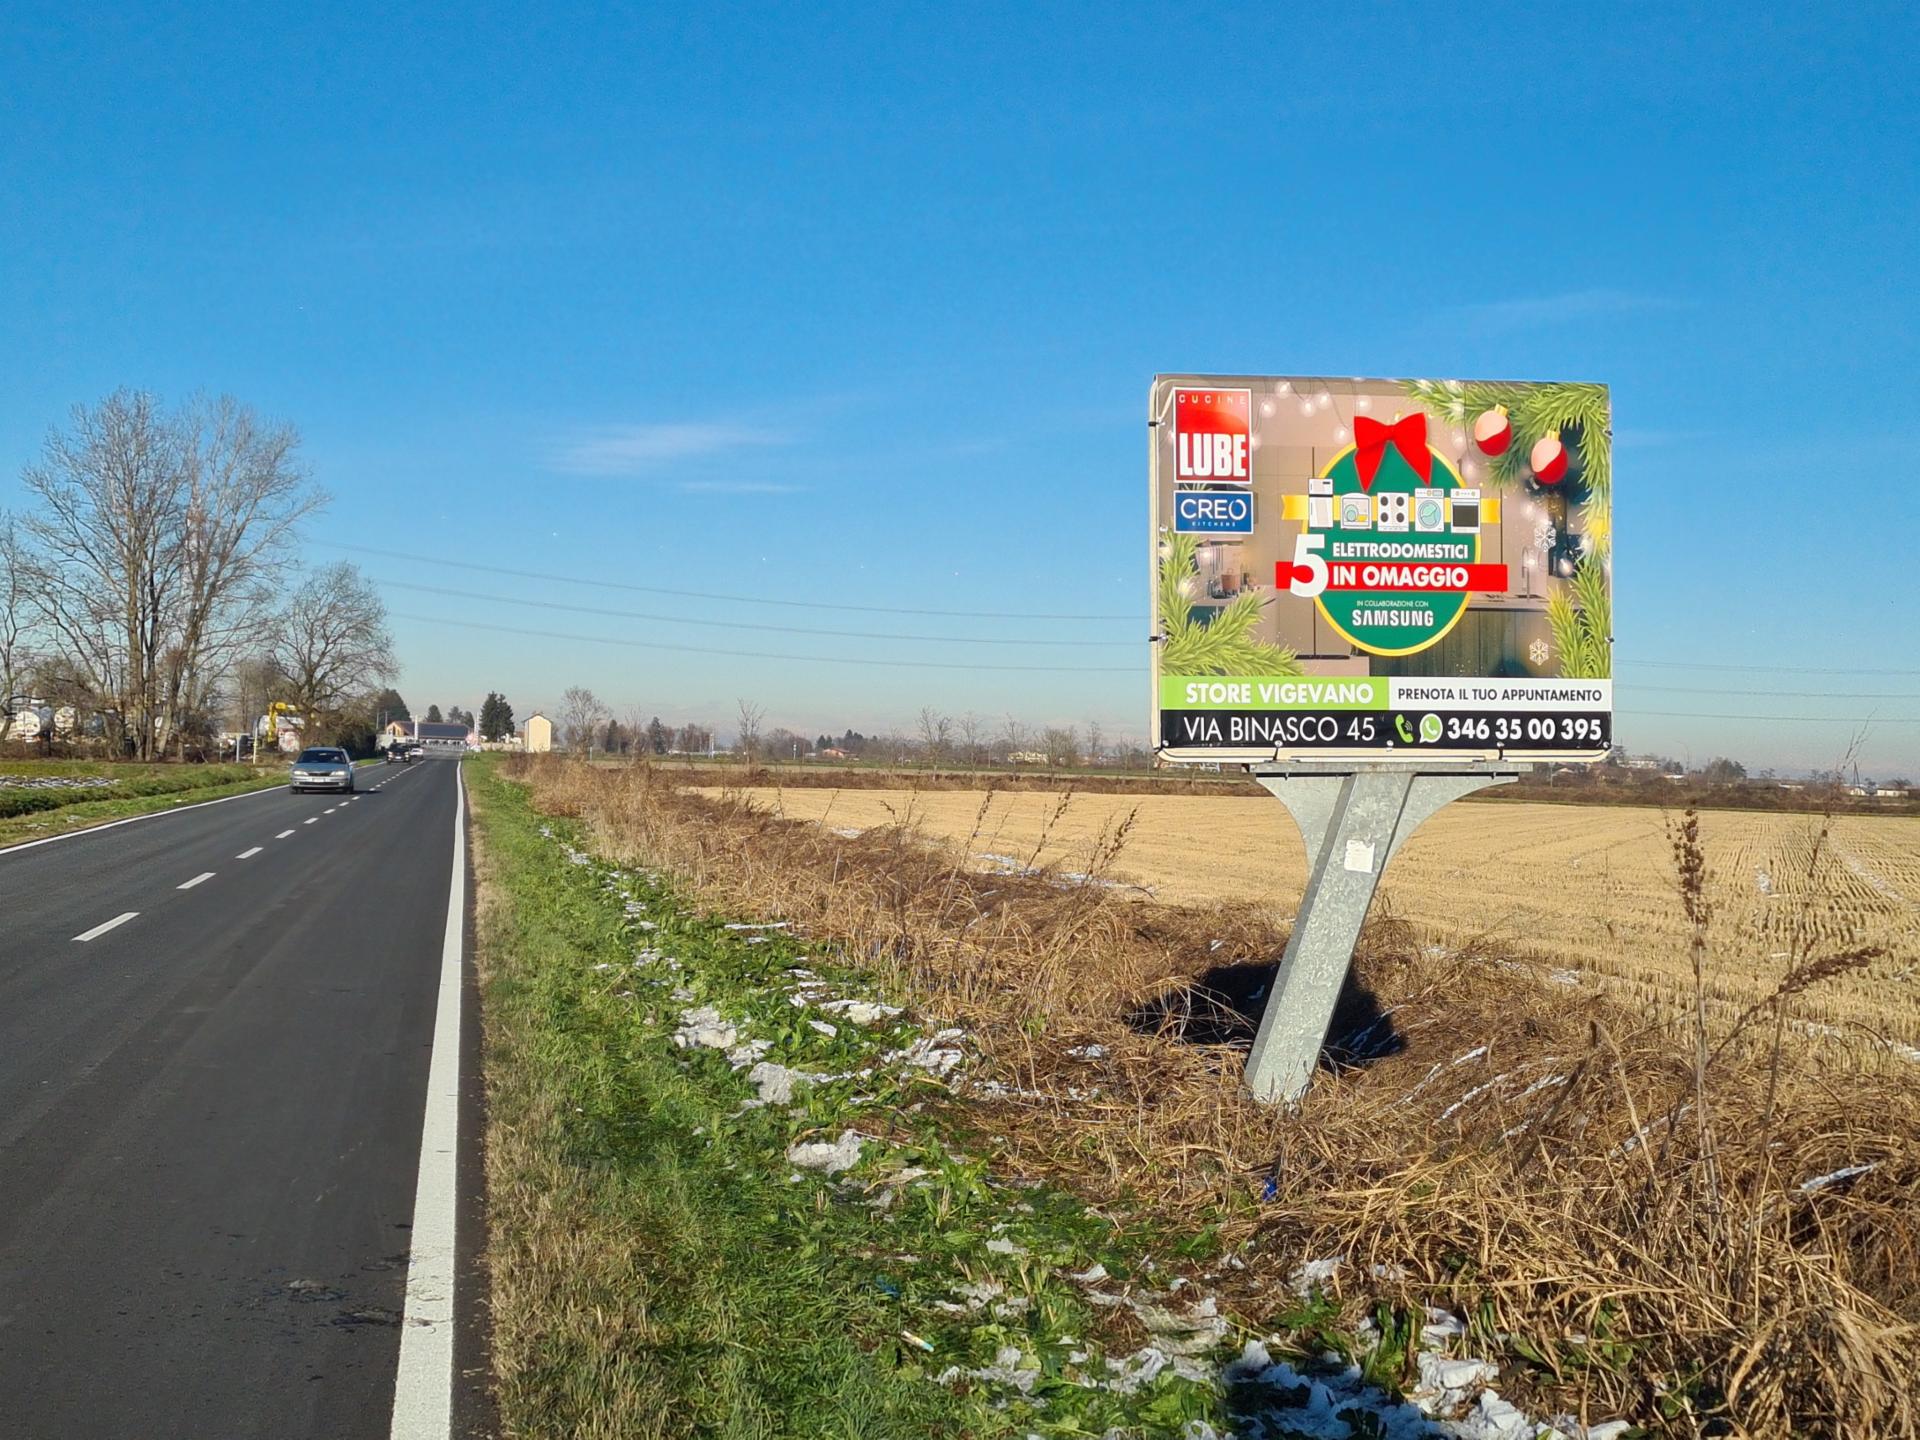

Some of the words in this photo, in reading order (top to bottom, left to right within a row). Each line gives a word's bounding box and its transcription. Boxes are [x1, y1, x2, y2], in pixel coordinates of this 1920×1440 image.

[1178, 394, 1246, 405] CUCINE
[1179, 432, 1247, 477] LUBE
[1180, 498, 1247, 520] CREO
[1332, 542, 1469, 559] ELETTRODOMESTICI
[1290, 534, 1329, 597] 5
[1332, 565, 1356, 586] IN
[1362, 566, 1469, 588] OMAGGIO
[1364, 600, 1414, 608] COLLABORAZIONE
[1352, 610, 1434, 626] SAMSUNG
[1185, 683, 1252, 704] STORE
[1257, 683, 1374, 704] VIGEVANO
[1398, 688, 1455, 700] PRENOTA
[1459, 689, 1468, 700] IL
[1472, 689, 1497, 701] TUO
[1501, 689, 1602, 701] APPUNTAMENTO
[1184, 716, 1223, 741] VIA
[1230, 716, 1338, 742] BINASCO
[1347, 717, 1376, 742] 45
[1447, 718, 1490, 740] 346
[1495, 718, 1522, 740] 35
[1527, 718, 1556, 740] 00
[1561, 718, 1602, 741] 395
